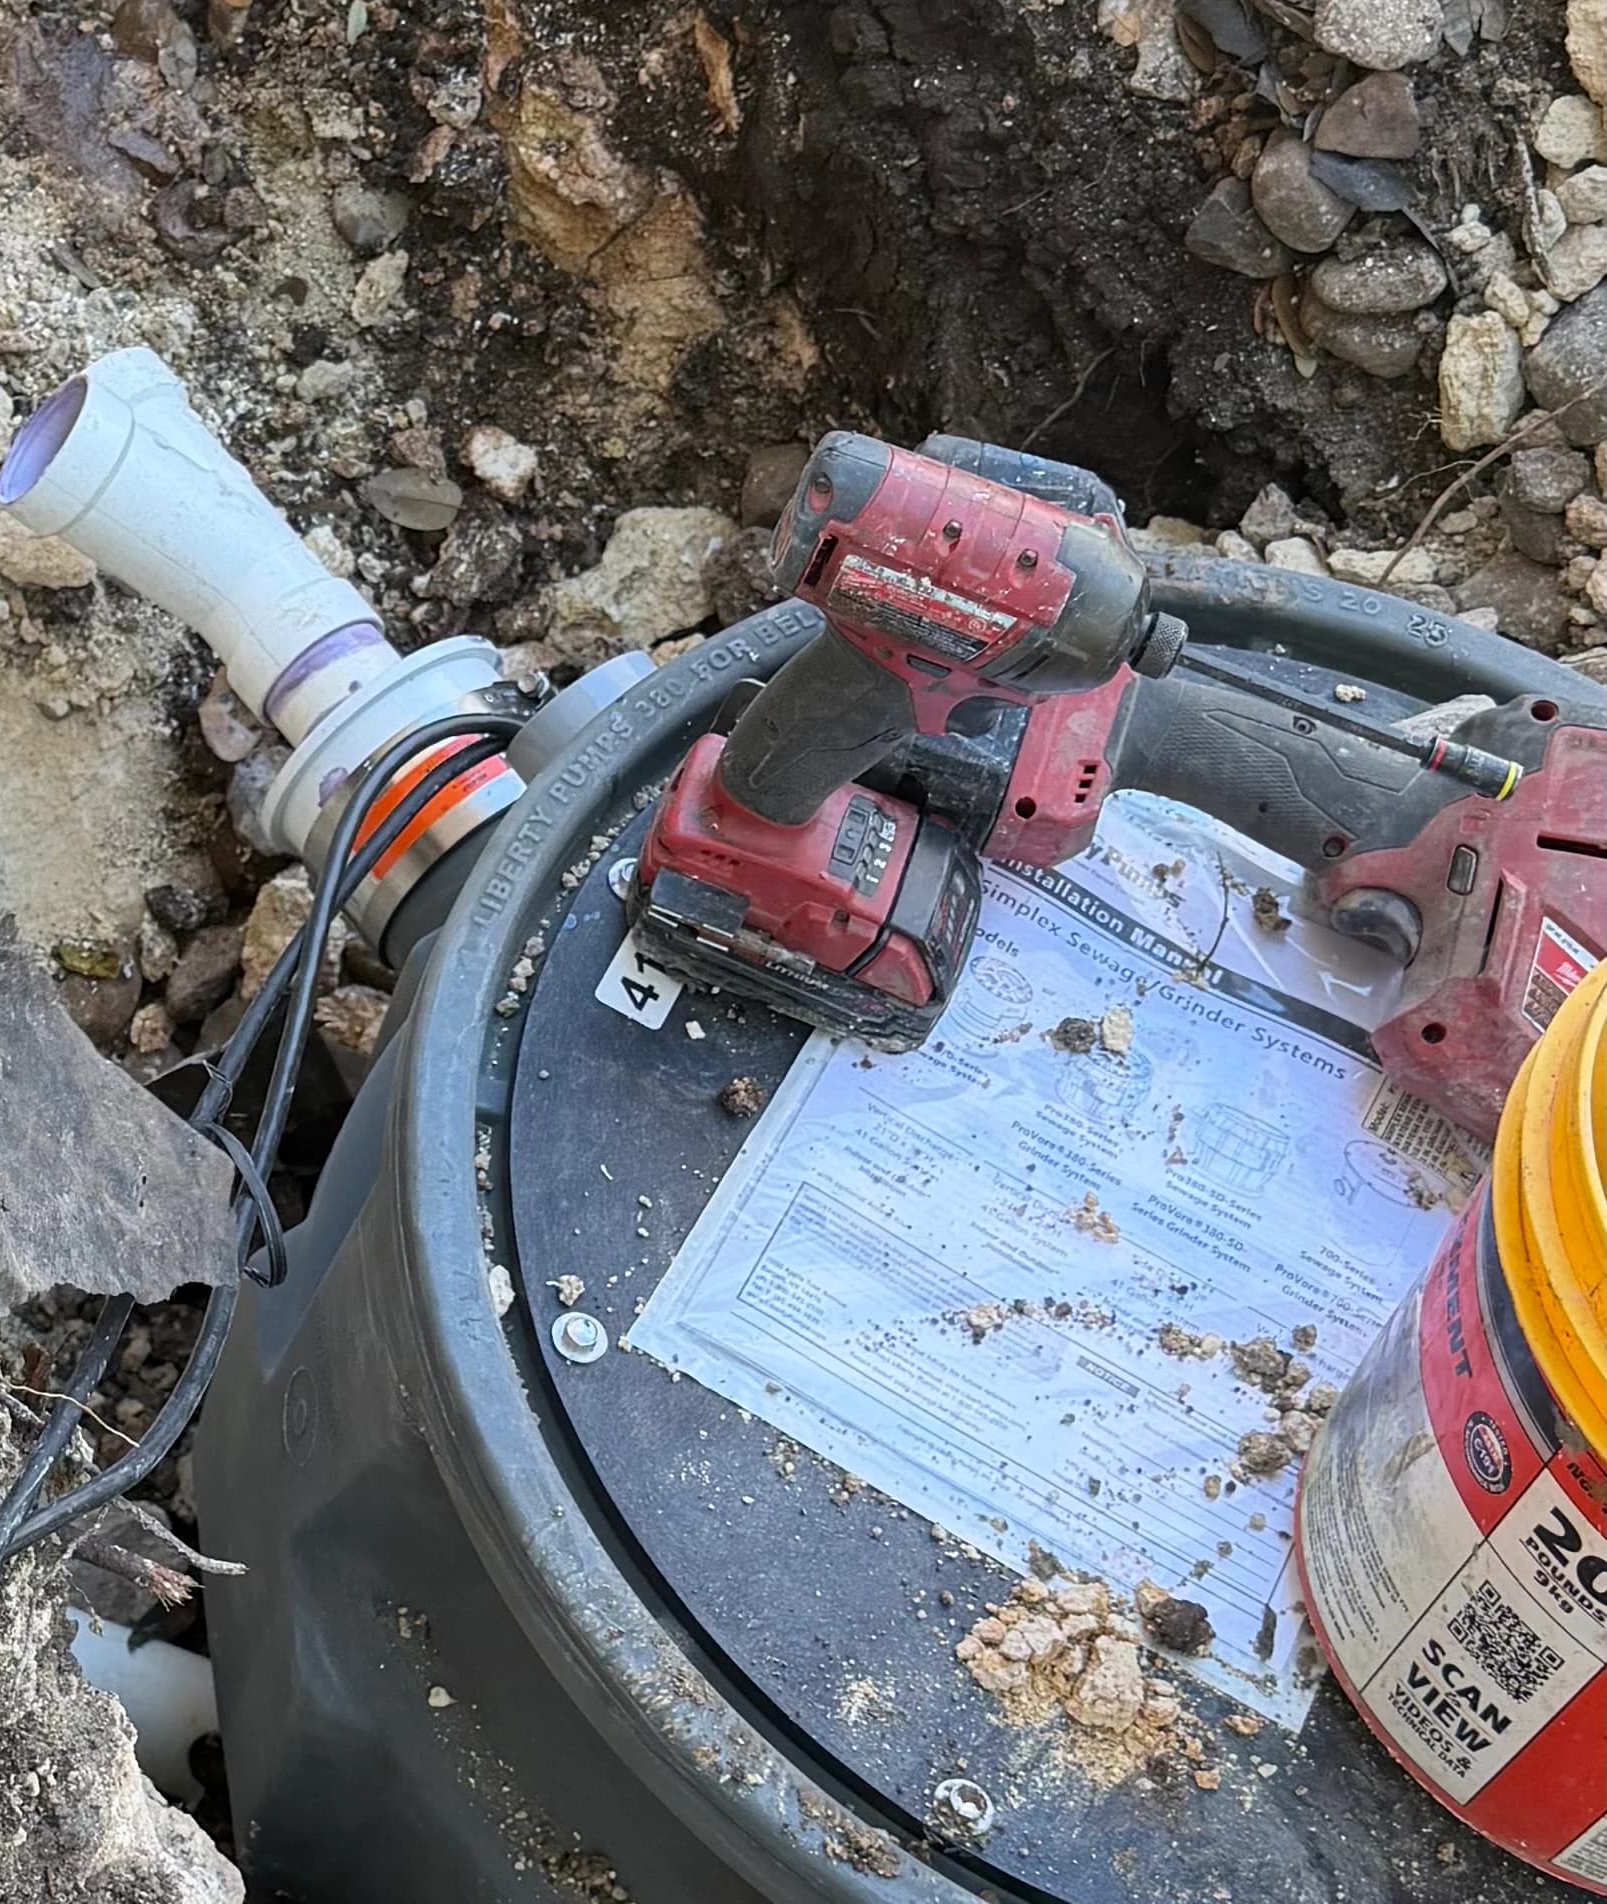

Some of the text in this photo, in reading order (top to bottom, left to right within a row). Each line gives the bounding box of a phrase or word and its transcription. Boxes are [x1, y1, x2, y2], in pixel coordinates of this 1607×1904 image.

[474, 805, 554, 925] LIBERTY
[551, 710, 634, 806] PUMPS
[634, 678, 689, 721] 380
[691, 639, 751, 683] FOR
[753, 609, 825, 647] BEL
[974, 925, 1022, 959] odels
[1251, 1024, 1349, 1083] Systems
[1018, 1140, 1102, 1191] Grinder System
[1130, 1202, 1252, 1273] Series Grinder System
[1209, 1203, 1252, 1231] System
[1281, 1284, 1325, 1314] Grinder
[1524, 1536, 1607, 1626] POUNDS
[1532, 1573, 1575, 1615] 9kg
[1393, 1682, 1454, 1755] VIDEOS
[1406, 1661, 1493, 1753] VIEW
[1422, 1637, 1513, 1735] SCAN
[1387, 1692, 1468, 1779] TECHNICAL DATA
